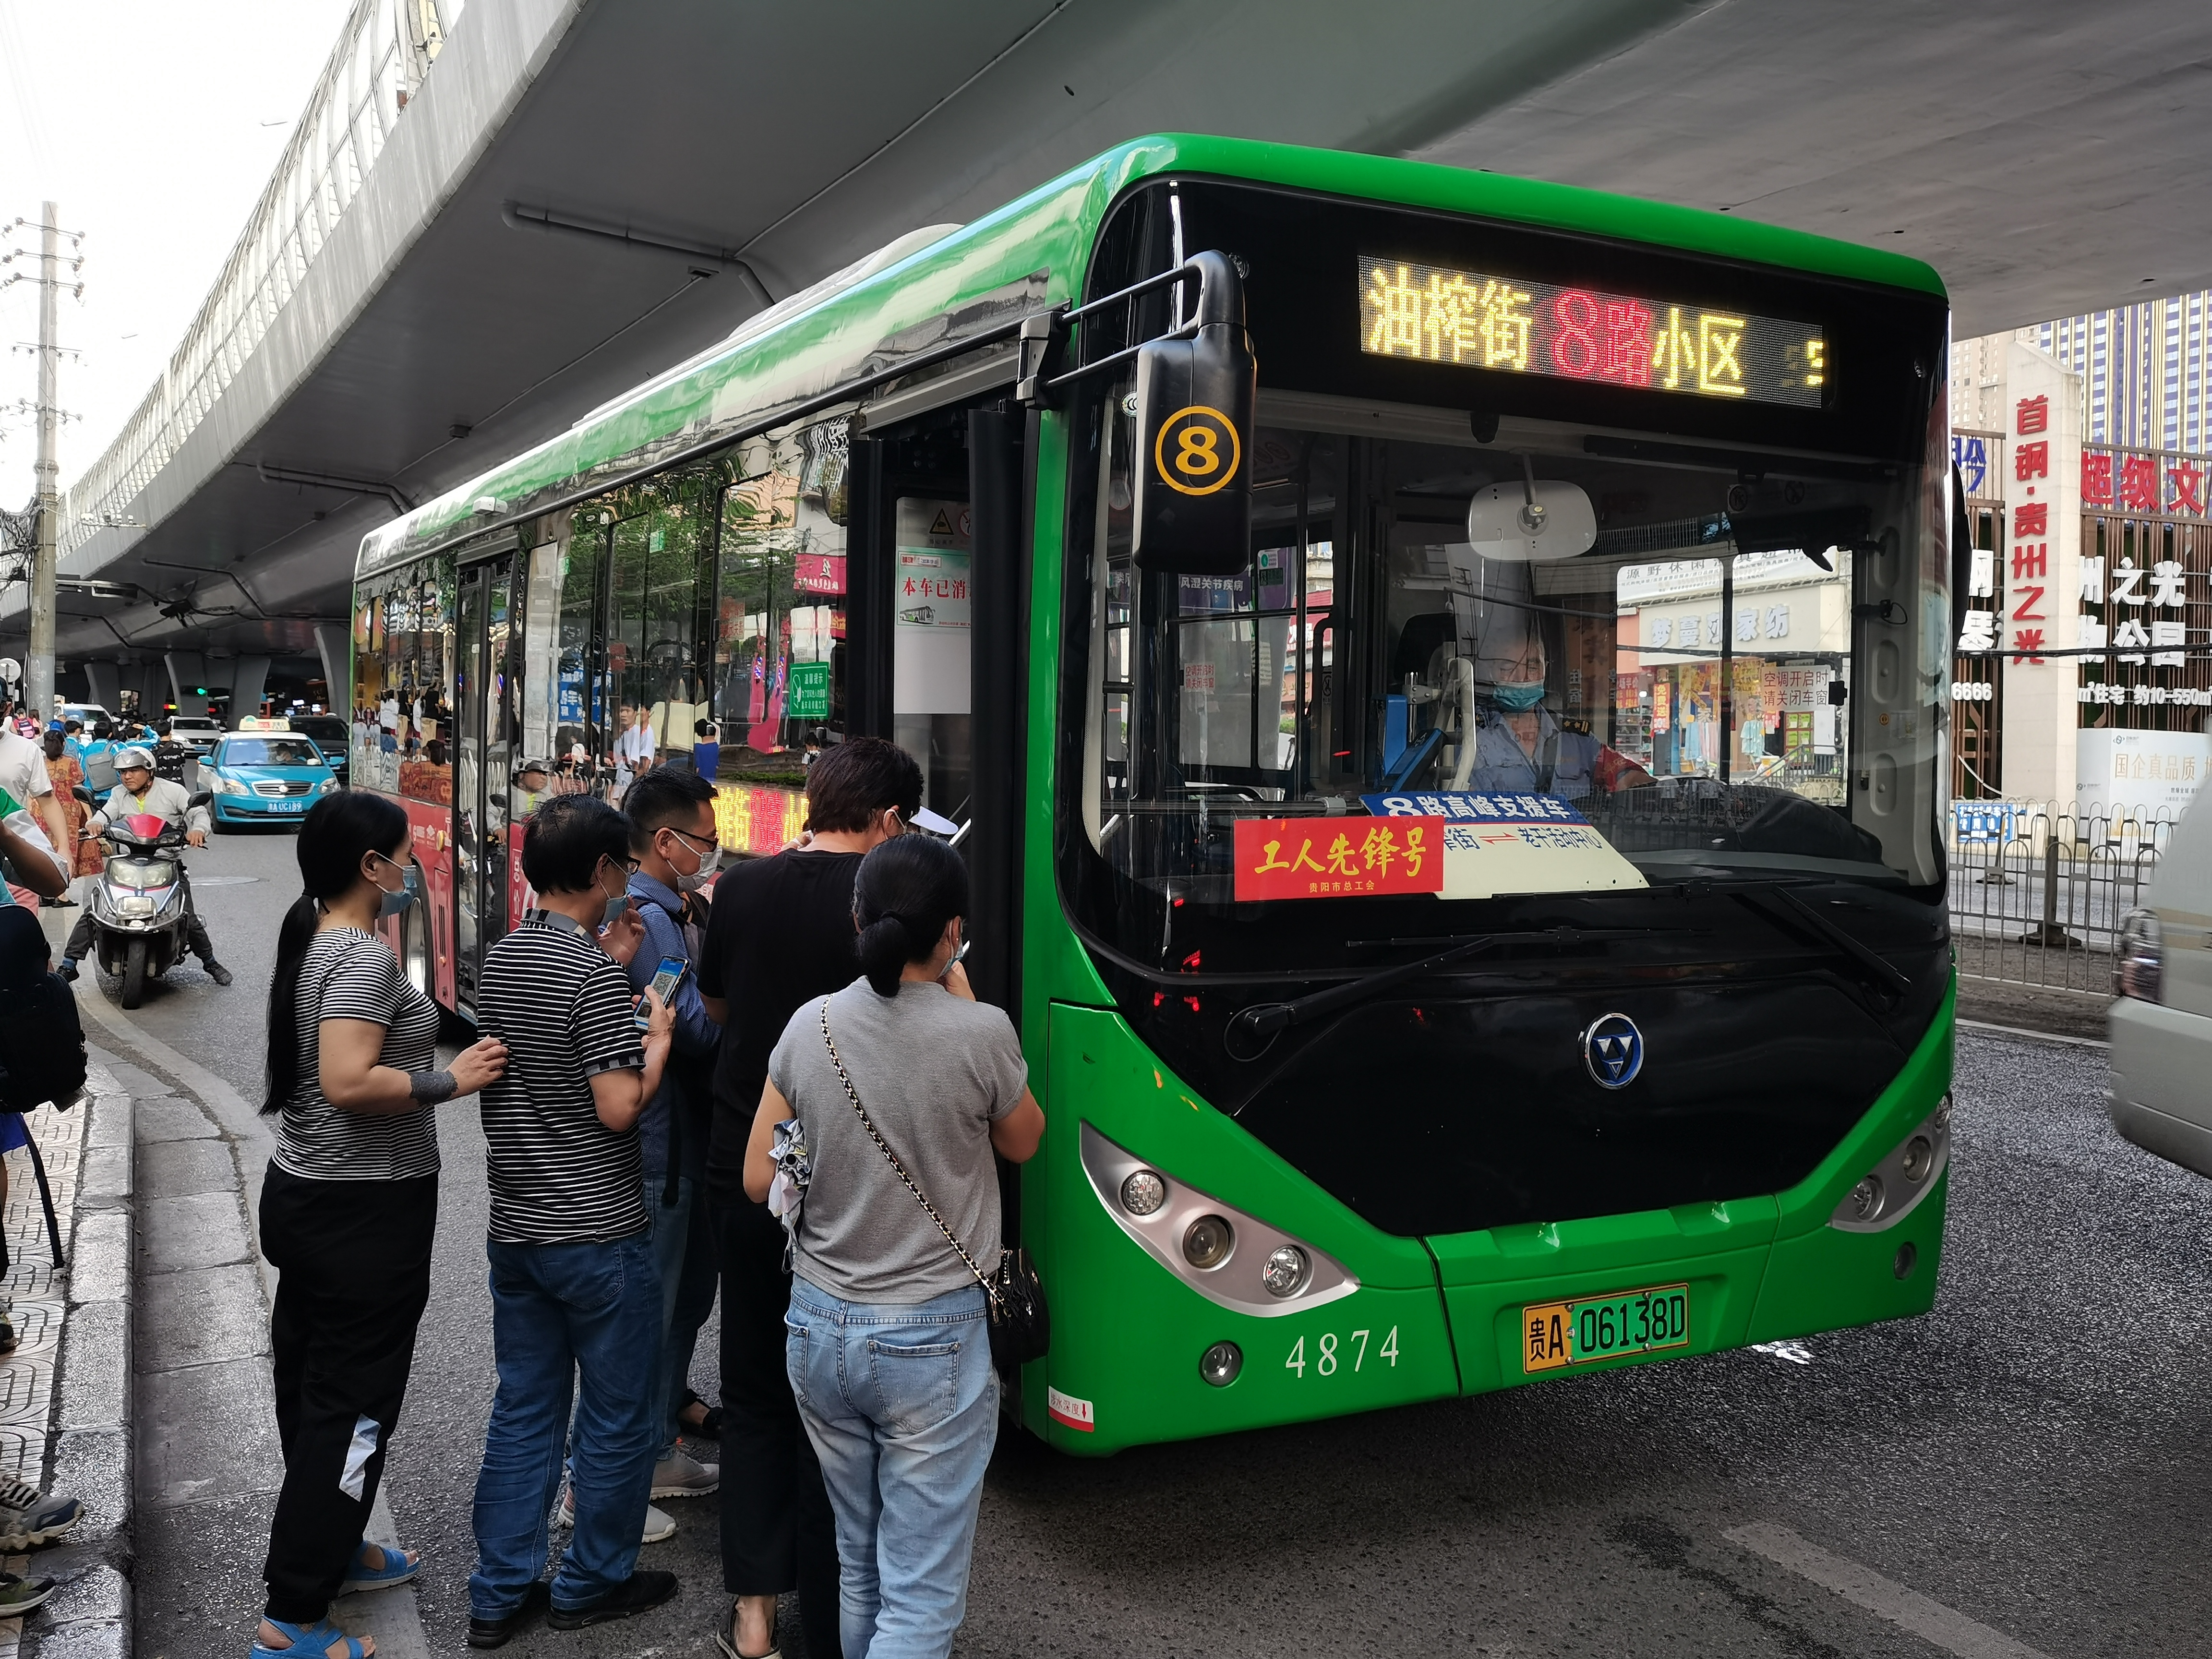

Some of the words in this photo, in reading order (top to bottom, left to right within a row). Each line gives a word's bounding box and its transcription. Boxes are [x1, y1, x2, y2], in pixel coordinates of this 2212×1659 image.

[1176, 426, 1219, 475] 8
[902, 577, 971, 600] 本车已消
[1180, 577, 1244, 591] 风湿关节疾病
[1764, 670, 1828, 687] 空调开启时
[1764, 690, 1828, 706] 请关闭车窗
[2115, 753, 2196, 781] 国企真品质
[1382, 795, 1571, 818] 8路高峰支援车
[1517, 826, 1603, 849] 老干活动中心
[1309, 880, 1374, 893] 贵阳市总工会
[1285, 1324, 1399, 1378] 4874
